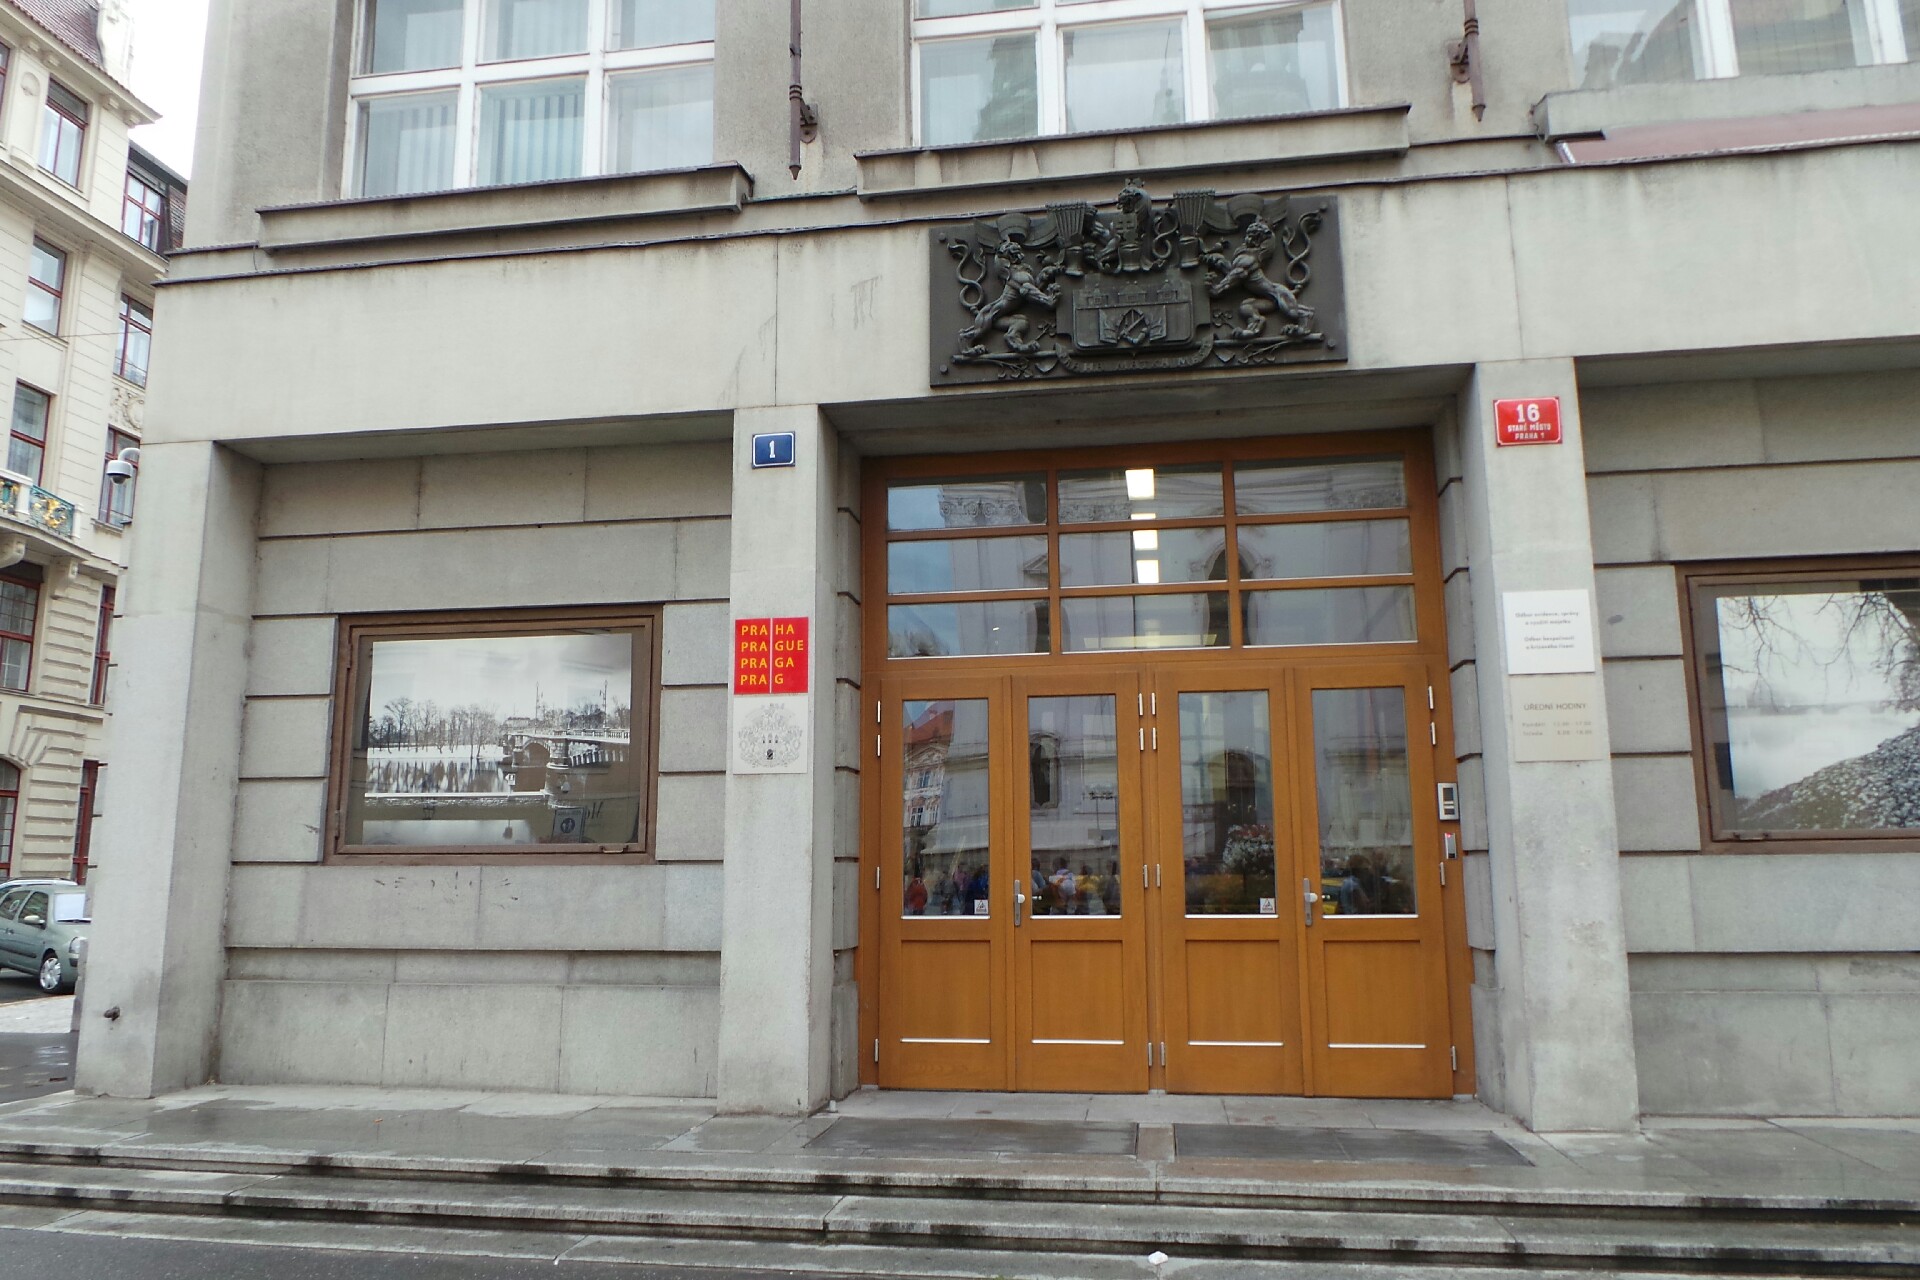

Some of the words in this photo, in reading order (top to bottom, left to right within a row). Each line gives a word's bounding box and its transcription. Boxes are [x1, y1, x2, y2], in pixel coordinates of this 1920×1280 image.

[1516, 403, 1541, 423] 16
[1514, 432, 1539, 440] PRAHA
[768, 440, 776, 459] 1
[1556, 702, 1587, 710] HODINY
